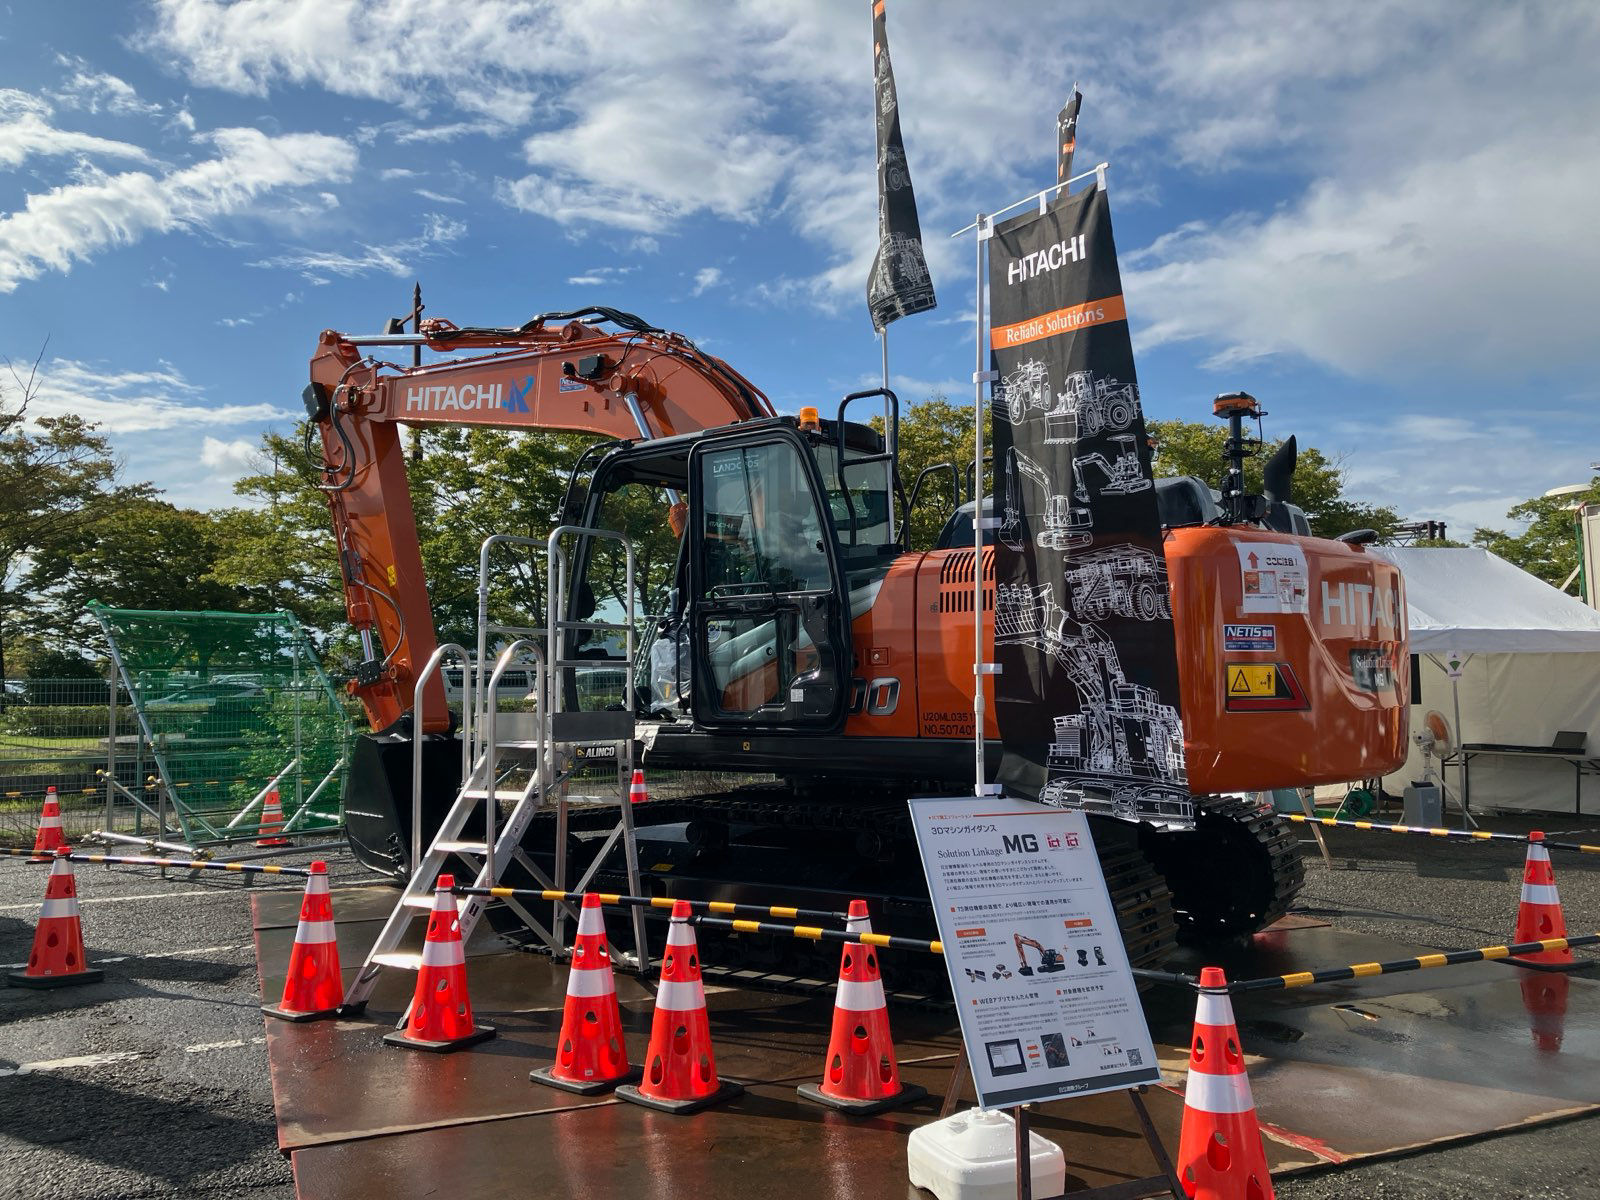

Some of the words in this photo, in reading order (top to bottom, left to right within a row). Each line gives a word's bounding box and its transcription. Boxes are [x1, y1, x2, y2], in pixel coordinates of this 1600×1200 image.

[1007, 233, 1086, 285] HITACHI
[1006, 321, 1044, 343] Reliable
[1046, 307, 1105, 333] Solutions
[406, 384, 502, 411] HITACHI
[713, 460, 759, 473] LANDCOS
[585, 746, 615, 758] ALINCO
[931, 824, 997, 835] 3Dマシンガイダンス
[937, 848, 971, 859] Solution
[972, 847, 1003, 857] Linkage
[1002, 833, 1039, 854] MG
